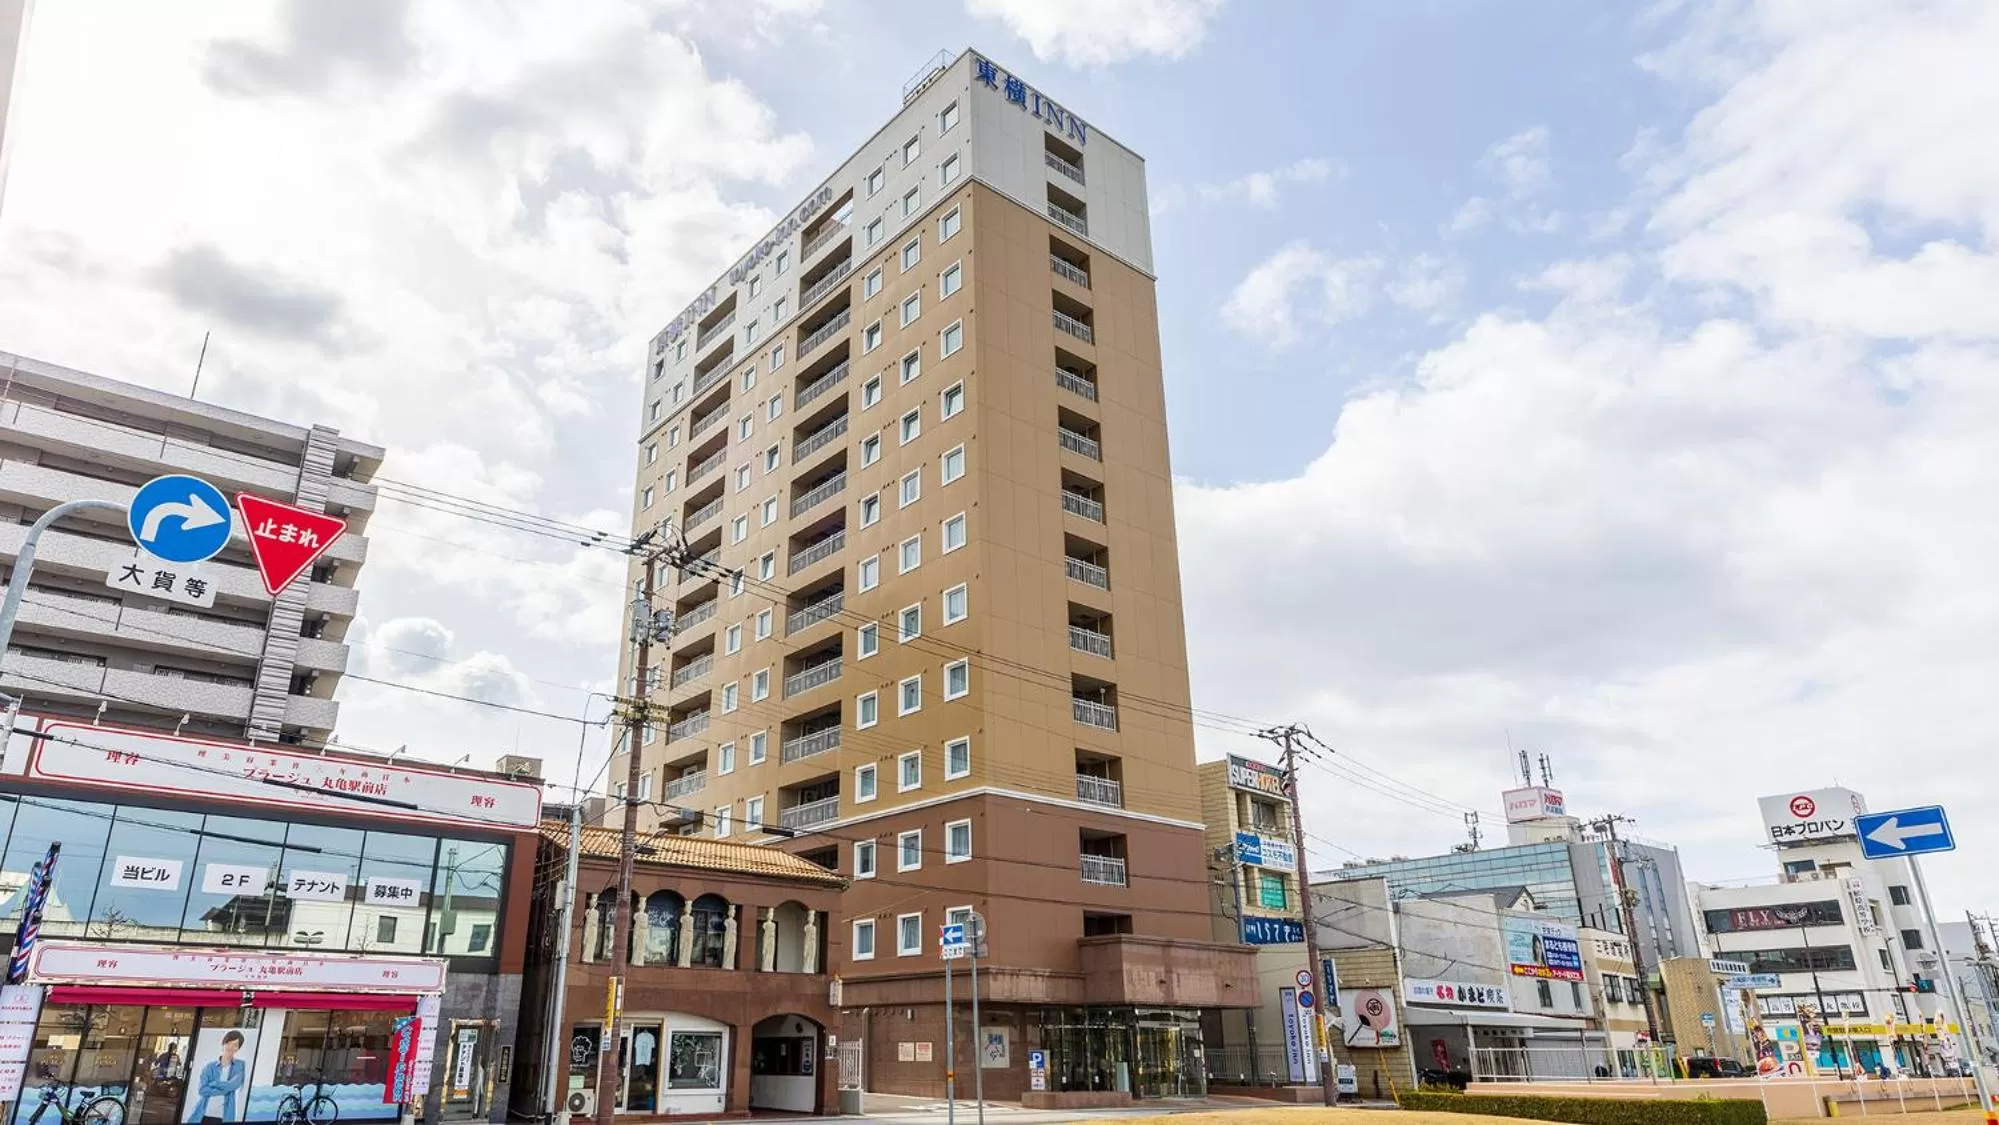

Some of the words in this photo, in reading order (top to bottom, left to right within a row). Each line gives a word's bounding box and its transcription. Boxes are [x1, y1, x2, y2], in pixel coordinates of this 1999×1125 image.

[974, 57, 1086, 146] 東横INN
[254, 517, 320, 550] 止まれ
[118, 563, 208, 599] 大貨等
[322, 776, 388, 796] 丸亀駅前店
[470, 795, 497, 809] 理容
[1771, 820, 1845, 838] 日本プロパン
[122, 864, 171, 882] 当ビル
[294, 878, 341, 895] テナント
[374, 884, 414, 901] 募集中
[1737, 909, 1771, 925] FLY
[210, 964, 253, 973] プラージュ
